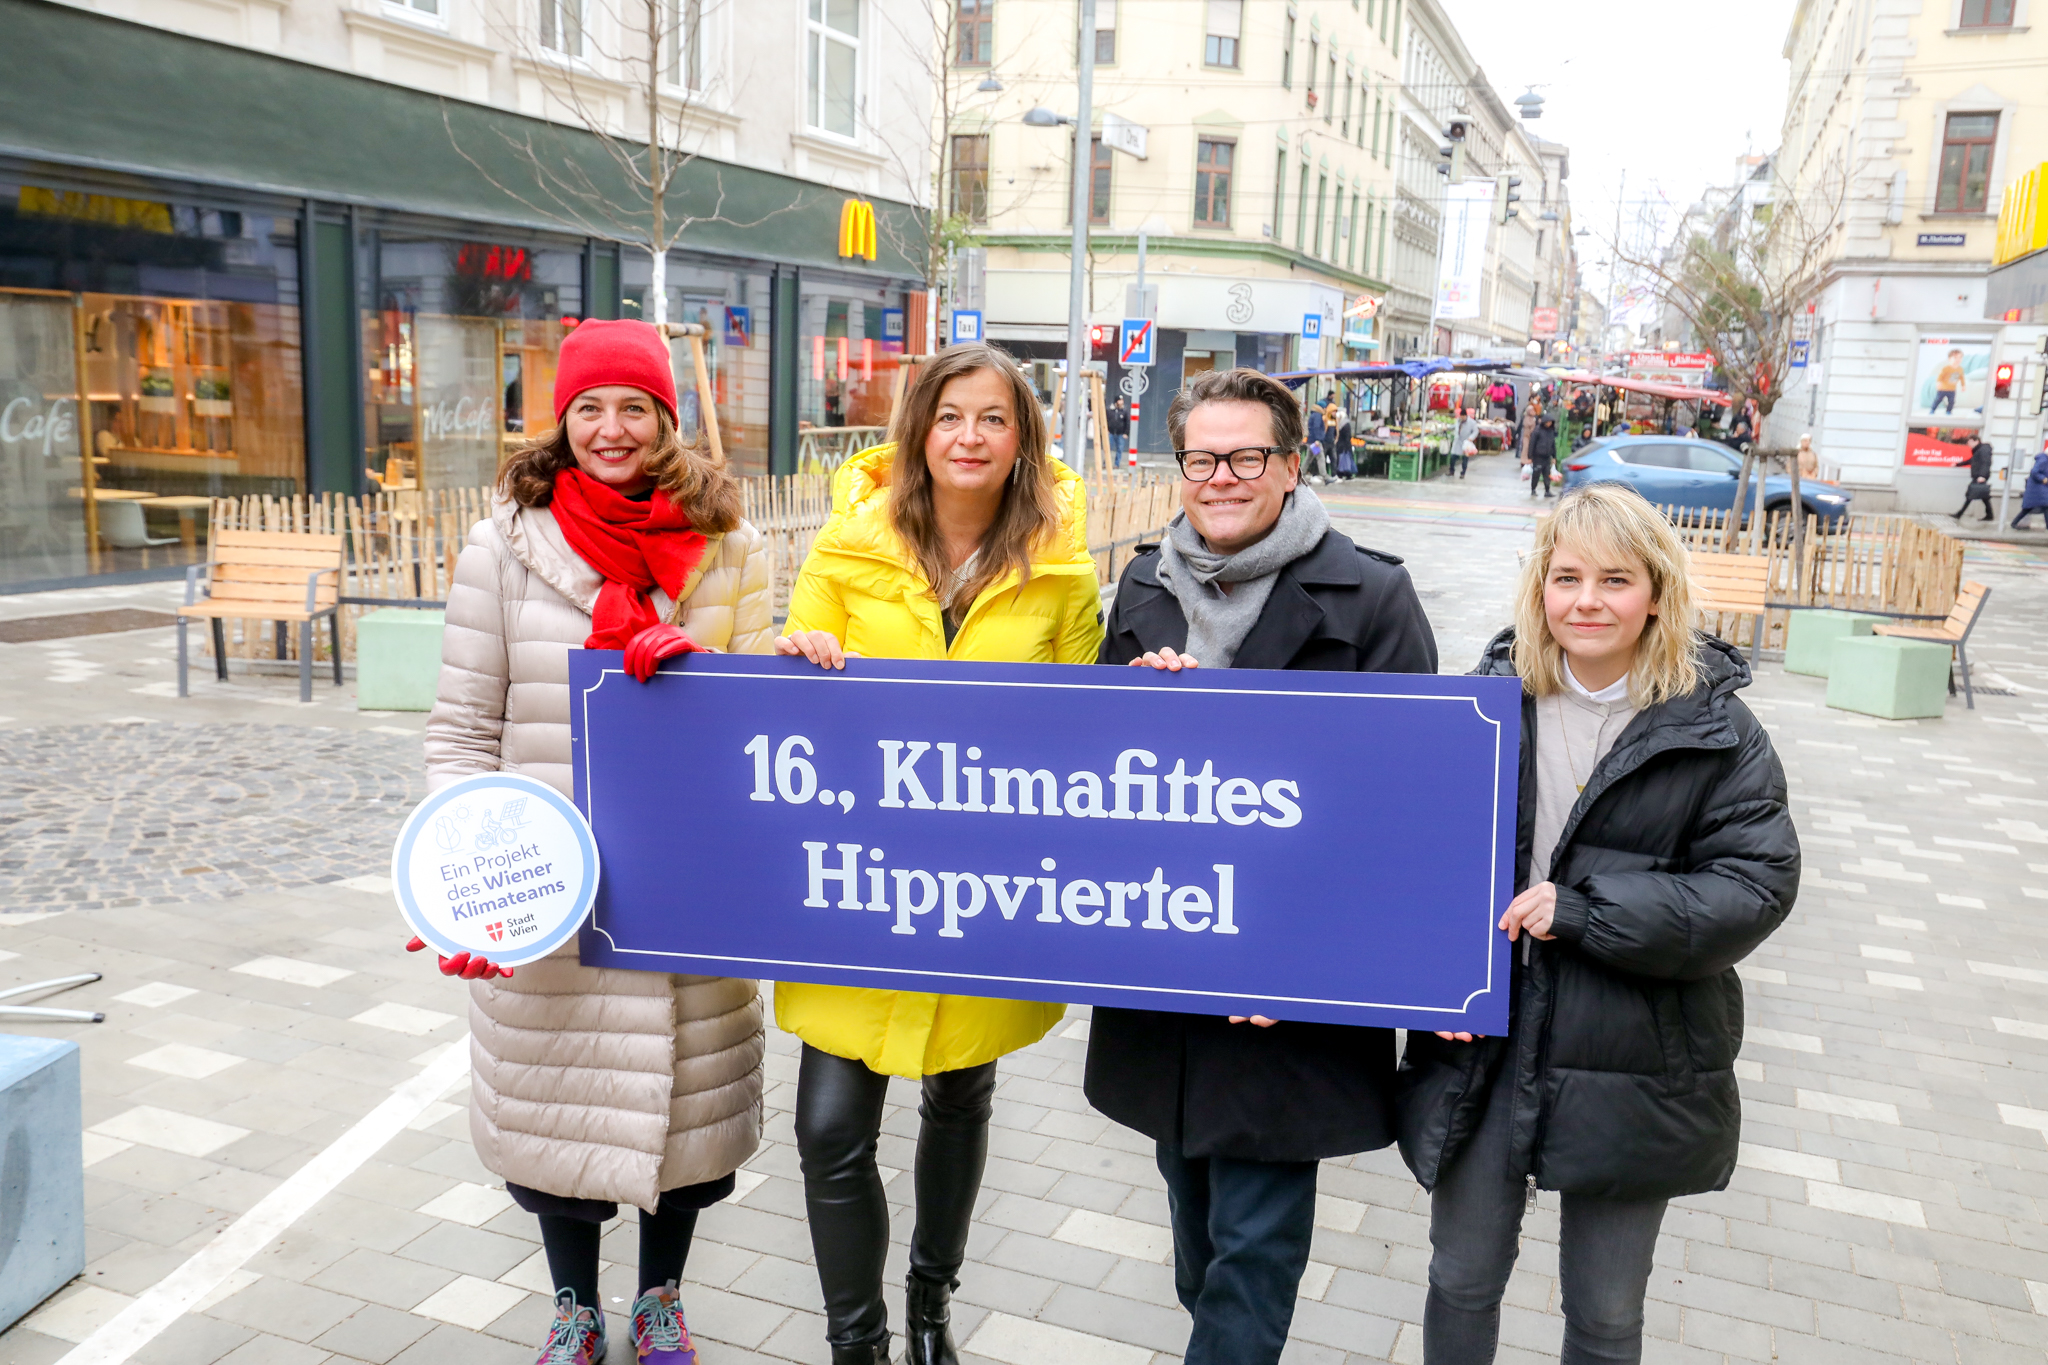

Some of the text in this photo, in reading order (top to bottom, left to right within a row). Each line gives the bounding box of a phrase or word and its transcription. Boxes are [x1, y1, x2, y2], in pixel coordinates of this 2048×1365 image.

[1226, 282, 1254, 325] 3
[958, 320, 976, 333] Taxi
[423, 396, 494, 442] McCafé
[744, 735, 1302, 828] 16., Klimafittes
[440, 843, 541, 882] Ein Projekt
[447, 862, 553, 901] des Wiener
[452, 881, 565, 921] Klimateams
[802, 841, 1239, 938] Hippviertel
[507, 912, 536, 928] Stadt
[509, 923, 537, 937] Wien
